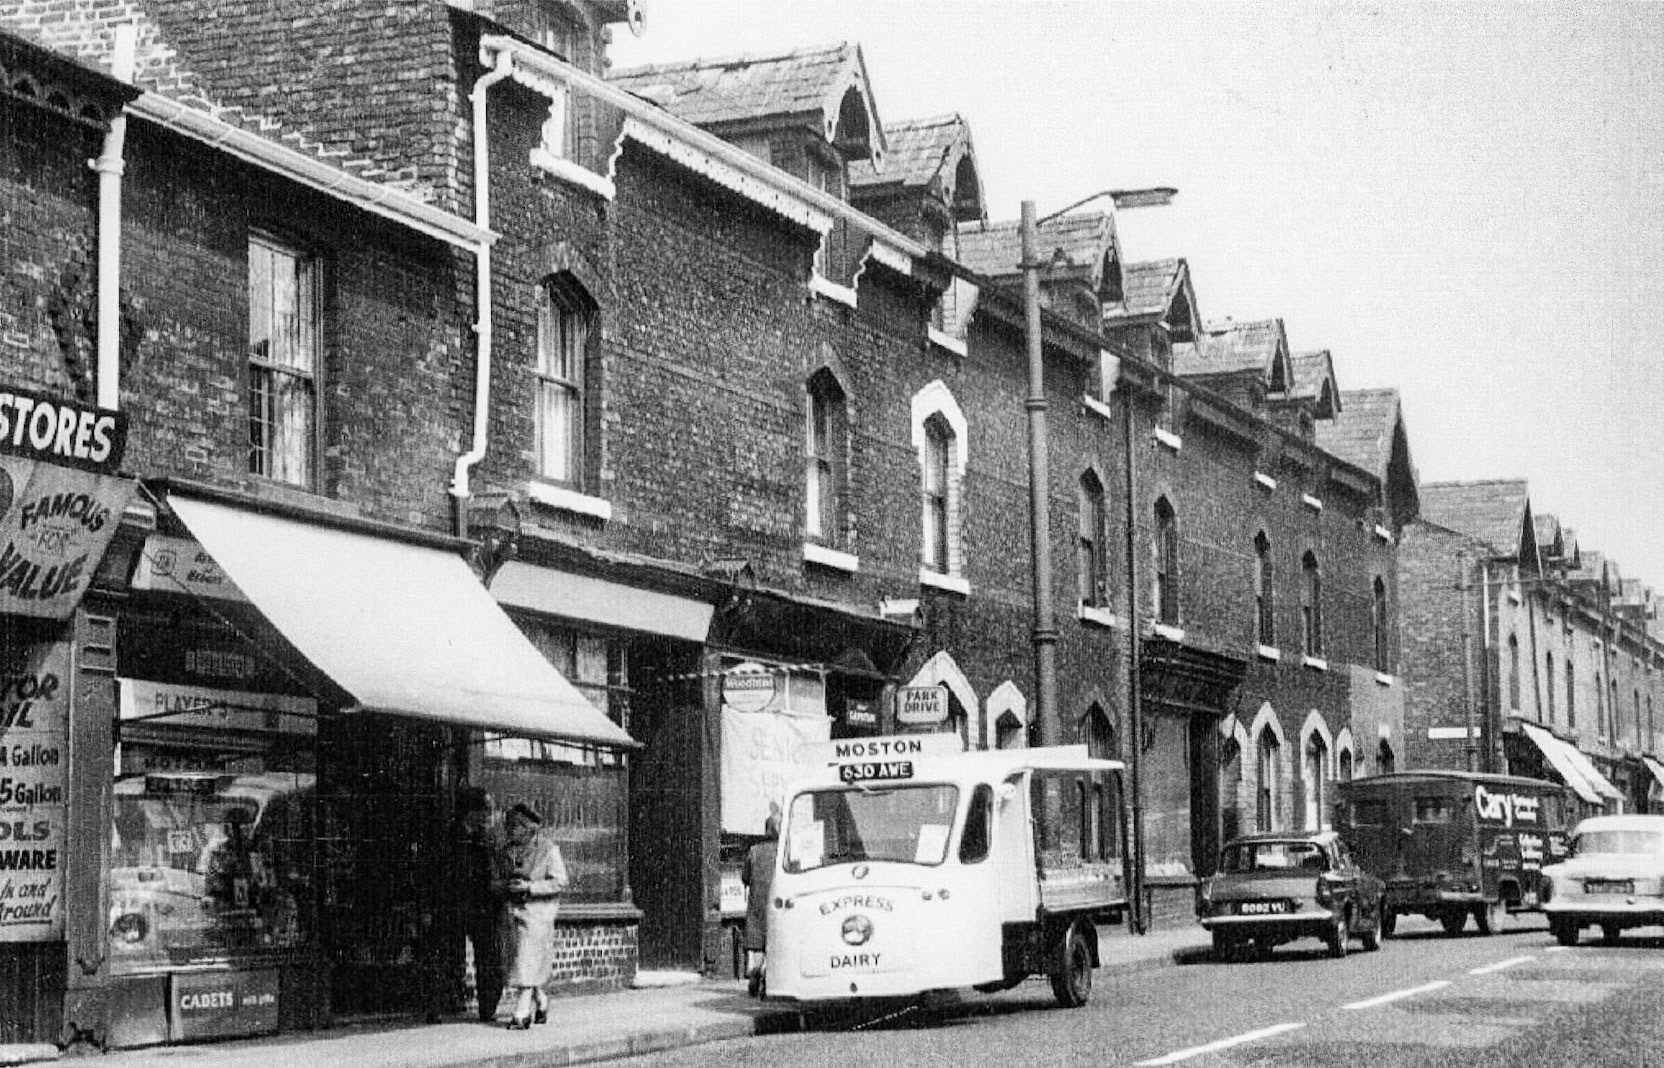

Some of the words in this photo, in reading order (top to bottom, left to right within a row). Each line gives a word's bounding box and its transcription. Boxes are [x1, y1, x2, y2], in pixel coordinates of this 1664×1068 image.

[0, 393, 116, 463] STORES
[20, 491, 110, 533] FAMOUS
[0, 540, 89, 600] VALUE
[905, 690, 938, 702] PARK
[903, 701, 941, 714] DRIVE
[12, 744, 59, 767] Gallon
[835, 740, 922, 757] MOSTON
[879, 762, 911, 778] AWE
[15, 782, 62, 806] Gallon
[0, 849, 57, 870] WARE
[18, 877, 52, 899] and
[818, 895, 895, 916] EXPRESS
[830, 953, 882, 969] DAIRY
[181, 991, 234, 1010] CADETS
